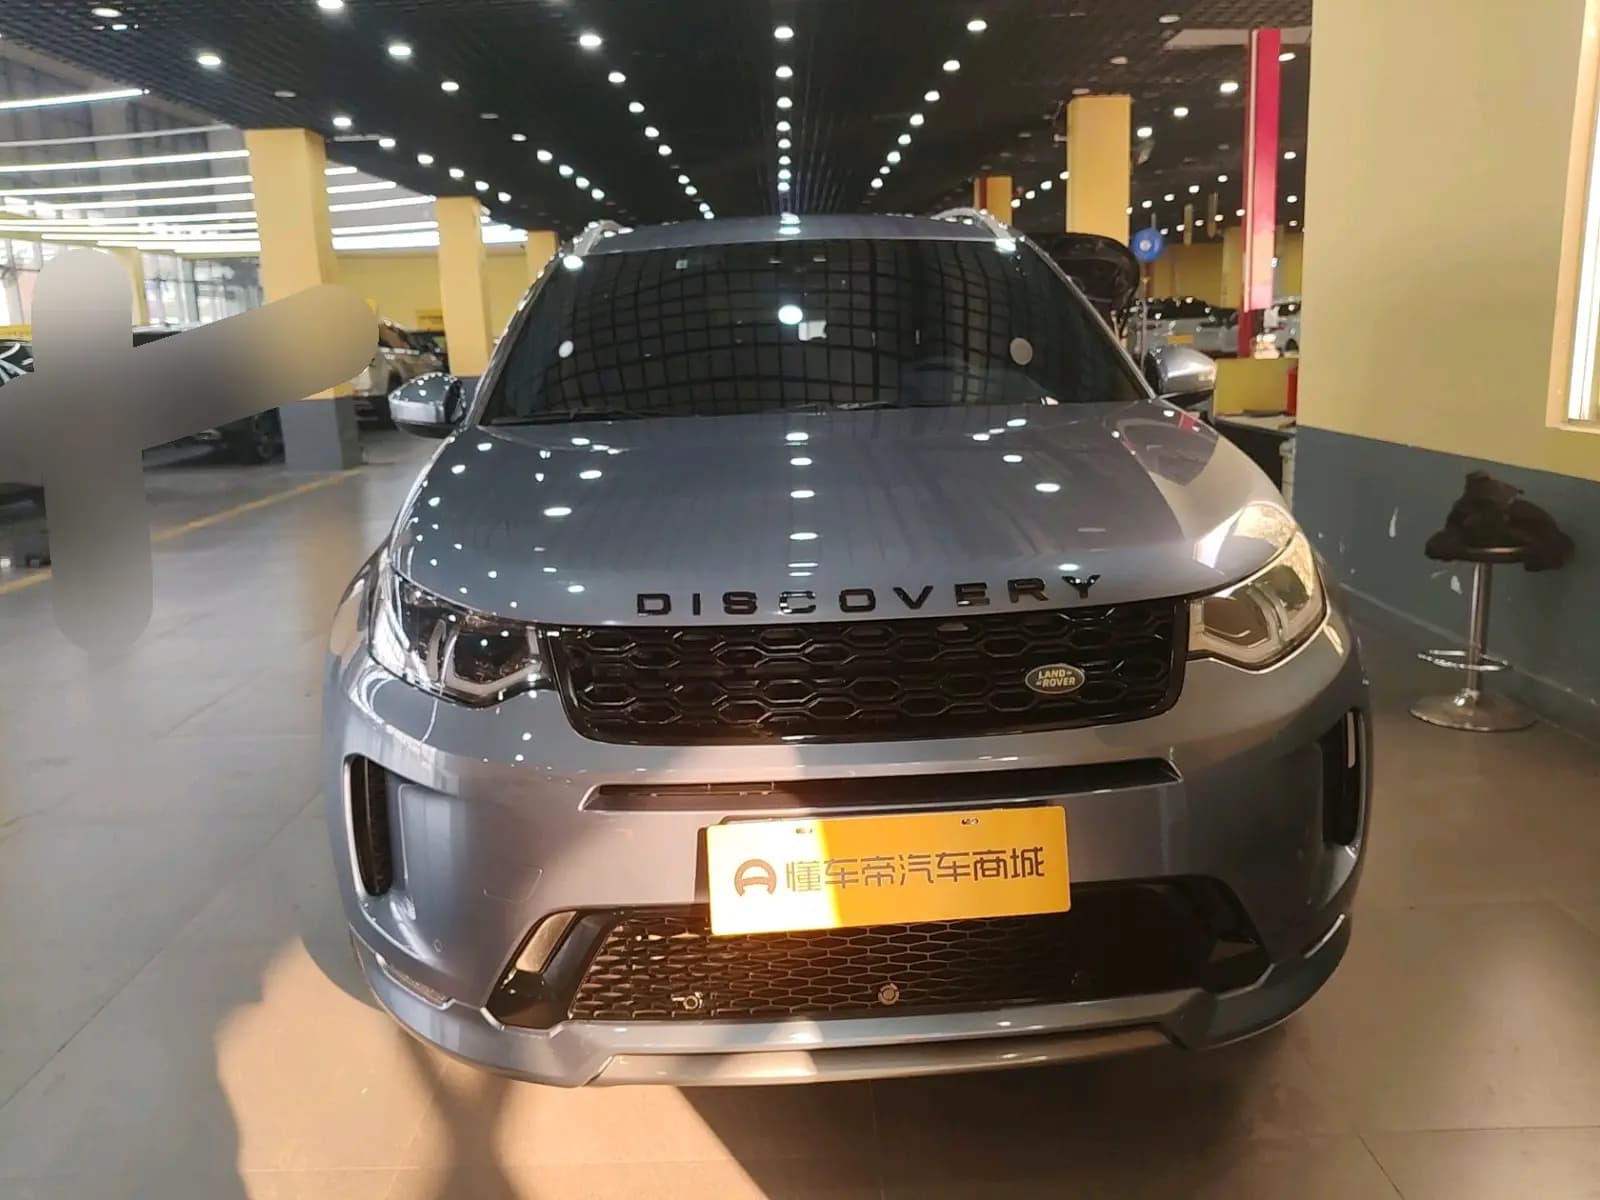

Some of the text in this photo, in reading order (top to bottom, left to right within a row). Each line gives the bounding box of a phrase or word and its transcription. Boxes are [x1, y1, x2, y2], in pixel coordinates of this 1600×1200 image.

[636, 574, 1101, 616] DISCOVERY
[785, 846, 1046, 892] 懂车帝汽车商城
